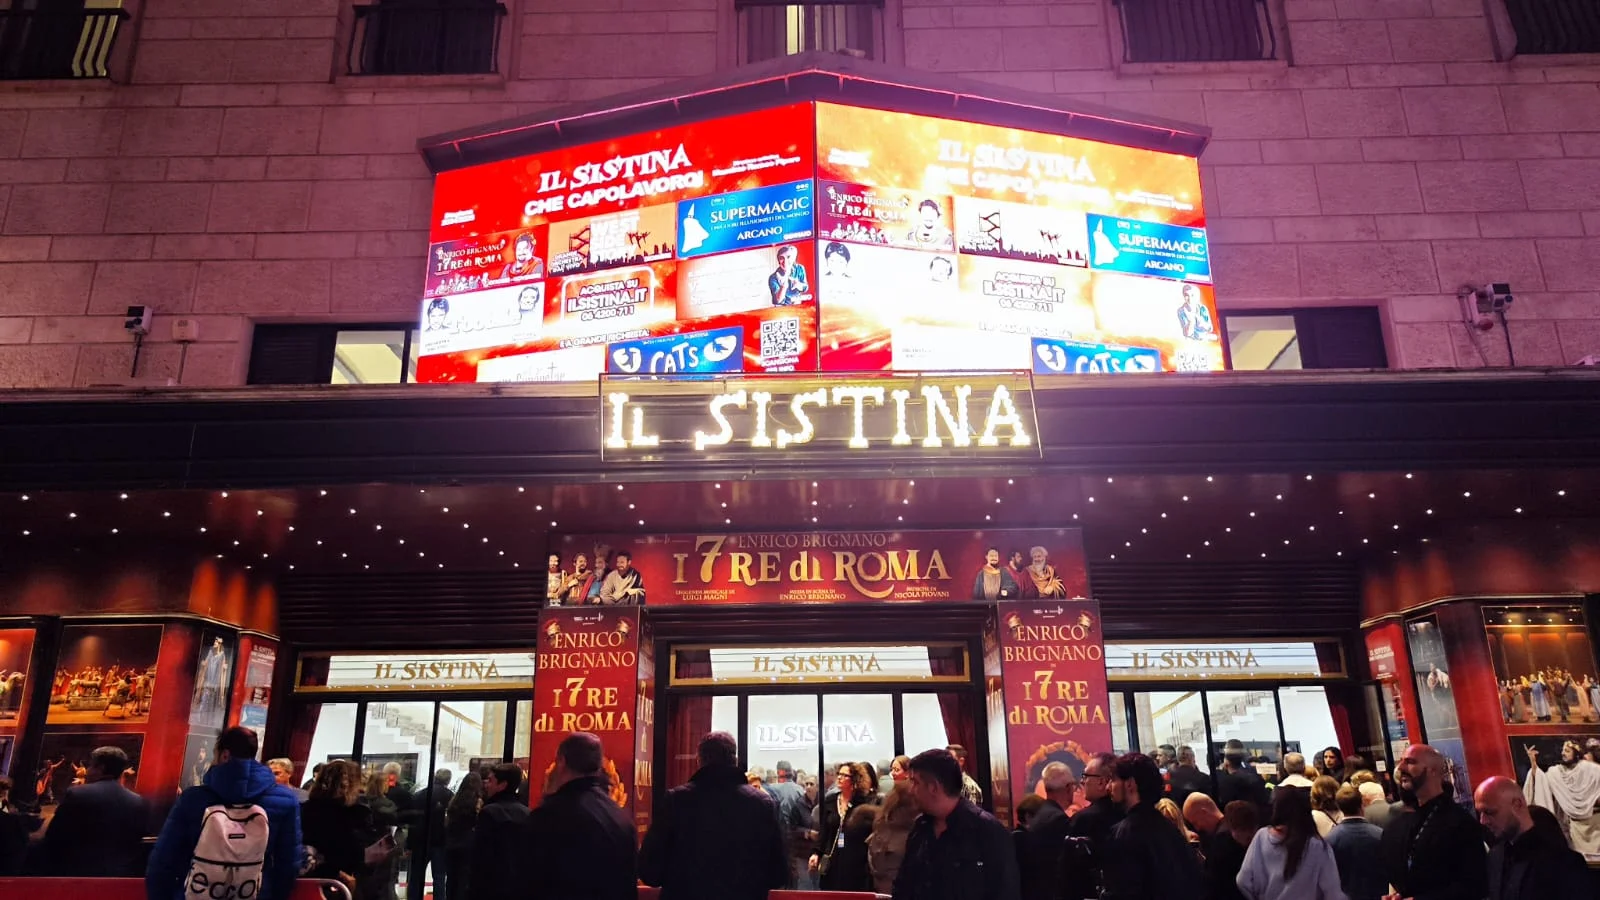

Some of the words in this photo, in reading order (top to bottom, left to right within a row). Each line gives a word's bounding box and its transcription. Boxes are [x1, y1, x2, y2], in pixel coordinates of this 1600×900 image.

[537, 171, 567, 193] IL
[569, 143, 692, 190] SISTINA
[938, 139, 970, 163] IL
[973, 144, 1096, 183] SISTINA
[524, 195, 564, 216] CHE
[830, 191, 862, 204] ENRICO
[710, 196, 810, 224] SUPERMAGIC
[846, 205, 862, 217] RE
[737, 226, 783, 241] ARCANO
[1118, 232, 1206, 256] SUPERMAGIC
[1144, 260, 1185, 273] ARCANO
[580, 280, 625, 295] ACQUISTA
[626, 278, 639, 289] SU
[567, 288, 648, 312] ILSISTINA.IT
[651, 342, 699, 374] CATS
[607, 391, 659, 449] IL
[694, 385, 1032, 451] SISTINA
[738, 533, 798, 549] ENRICO
[802, 532, 886, 549] BRIGNANO
[672, 553, 689, 583] I
[694, 535, 727, 583] 7
[728, 551, 782, 586] RE
[833, 549, 953, 599] ROMA
[554, 631, 622, 649] ENRICO
[1016, 624, 1085, 642] ENRICO
[539, 651, 636, 670] BRIGNANO
[752, 656, 776, 673] IL
[780, 652, 883, 674] SISTINA
[1004, 645, 1102, 662] BRIGNANO
[1131, 651, 1155, 668] IL
[1160, 648, 1260, 670] SISTINA
[375, 663, 397, 680] IL
[401, 660, 500, 681] SISTINA
[552, 688, 563, 708] I
[565, 677, 586, 708] 7
[586, 687, 618, 709] RE
[1022, 681, 1032, 701] I
[1034, 670, 1055, 700] 7
[1056, 680, 1089, 702] RE
[561, 711, 632, 733] ROMA
[1034, 704, 1108, 735] ROMA
[759, 726, 780, 743] IL
[784, 724, 875, 744] SISTINA
